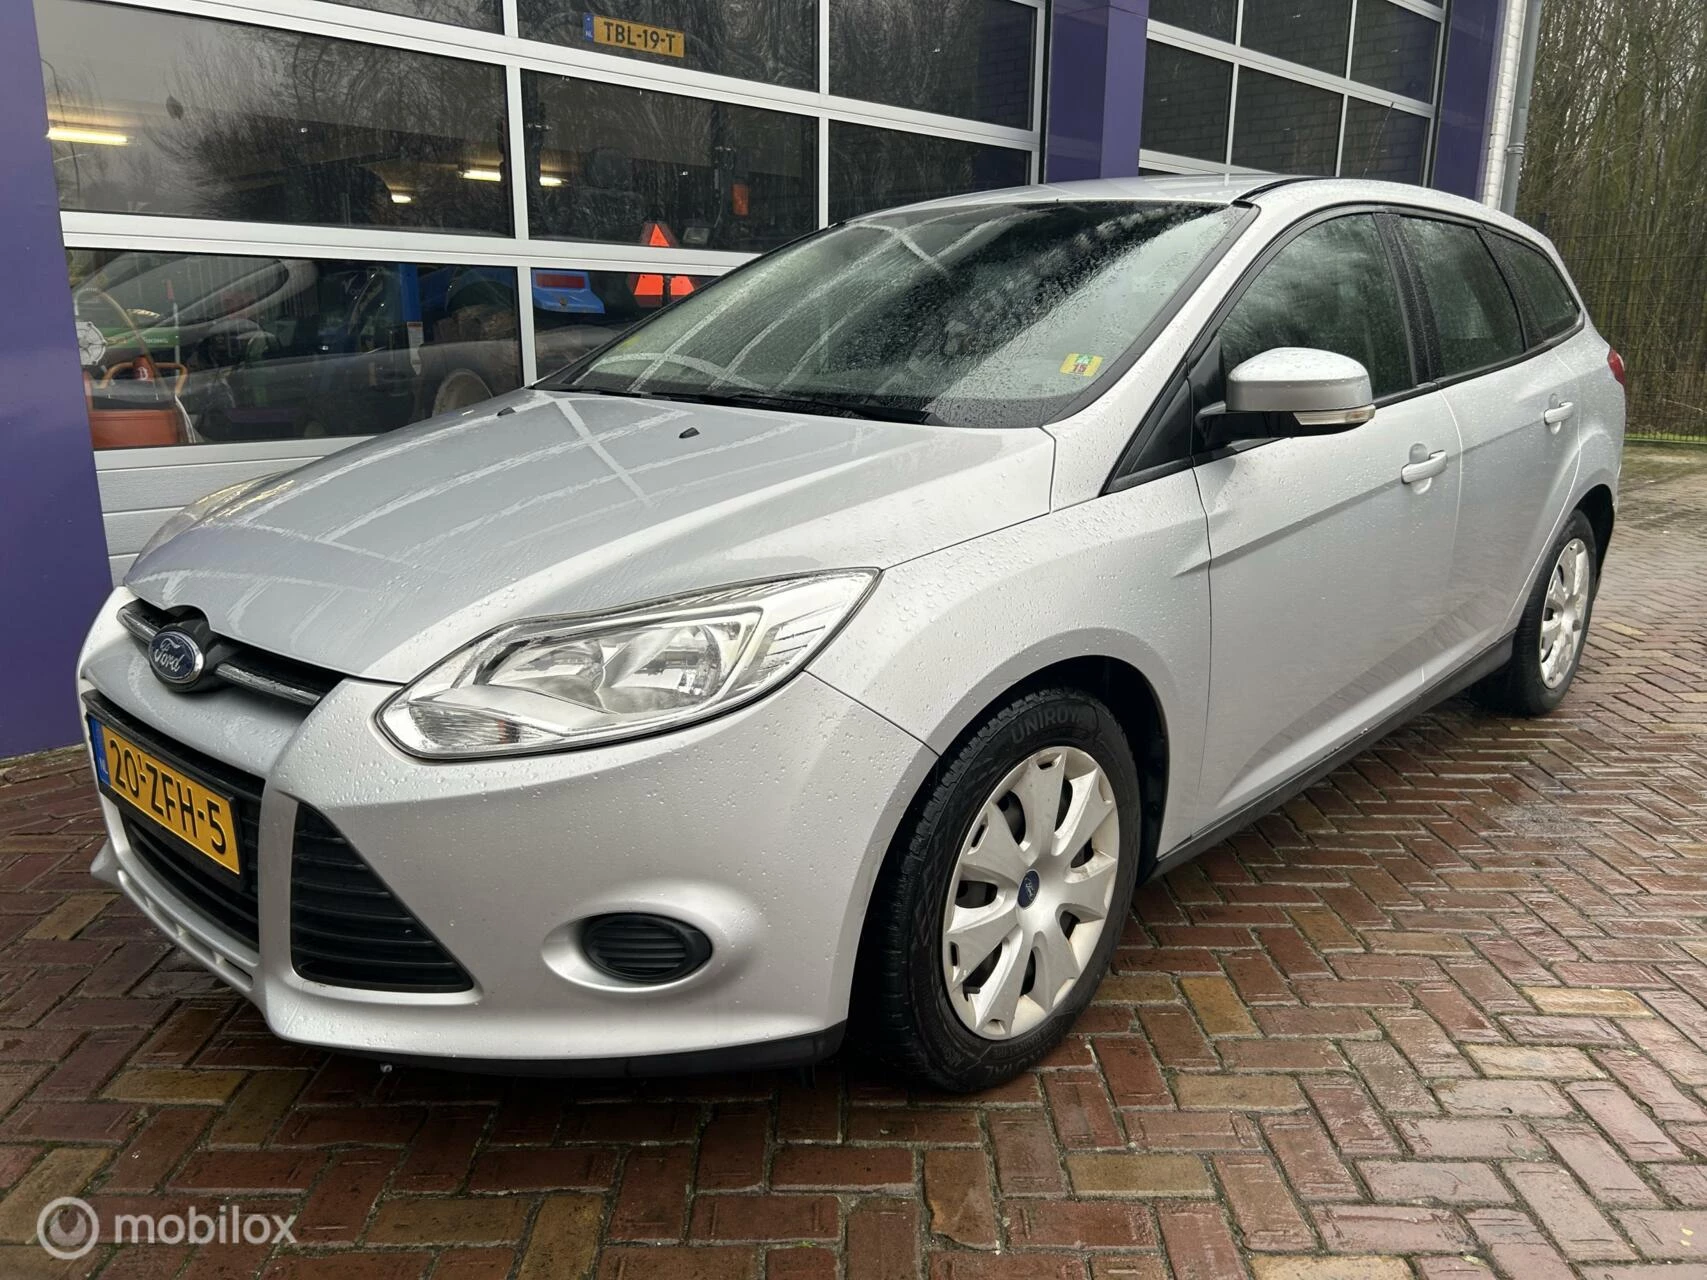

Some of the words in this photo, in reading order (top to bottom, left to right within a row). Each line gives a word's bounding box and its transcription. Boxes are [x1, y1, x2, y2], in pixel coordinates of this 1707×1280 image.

[604, 20, 676, 53] TBL-19-T
[154, 637, 186, 673] Ford
[109, 738, 227, 855] 20-ZFH-5
